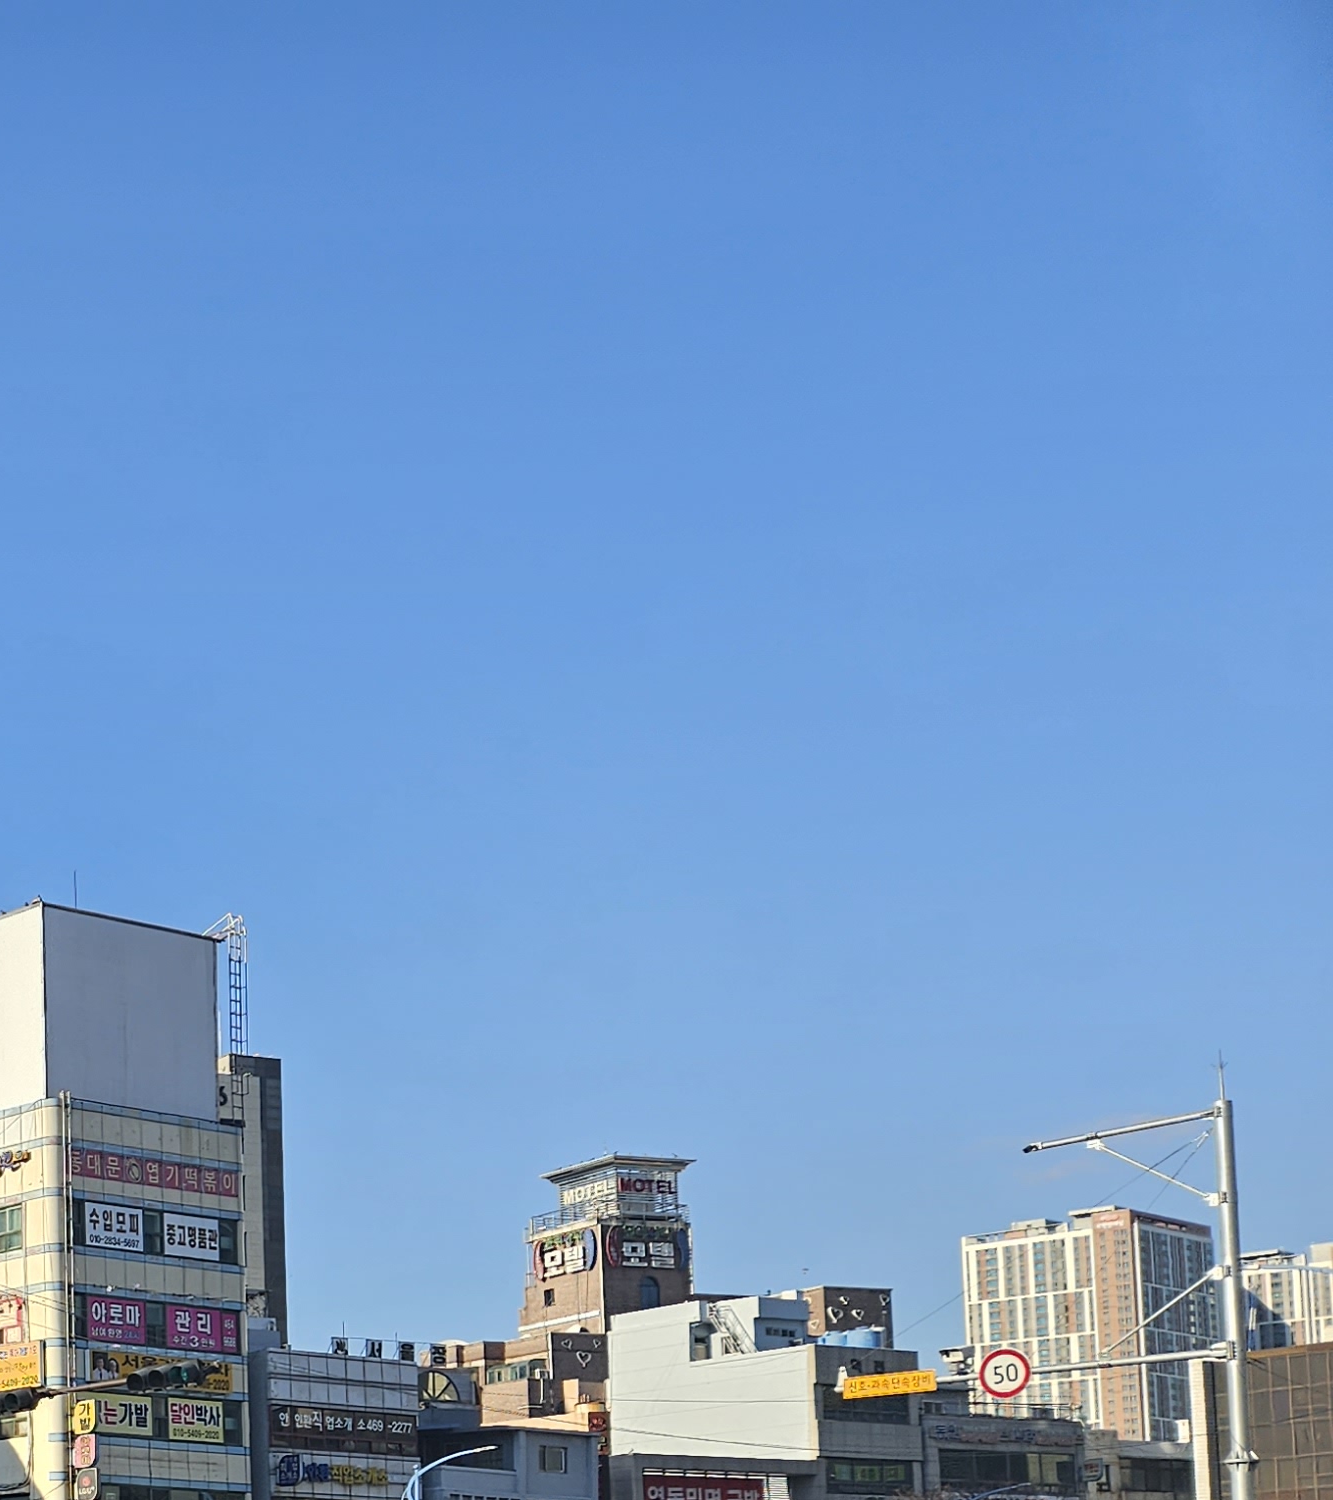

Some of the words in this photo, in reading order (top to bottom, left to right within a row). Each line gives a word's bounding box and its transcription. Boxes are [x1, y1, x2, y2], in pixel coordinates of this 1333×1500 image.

[145, 1161, 236, 1195] 엽기떡볶이
[618, 1177, 677, 1195] MOTEL
[562, 1180, 610, 1205] MOTEL
[89, 1207, 140, 1236] 수입모피
[166, 1223, 219, 1251] 중고명품관
[622, 1241, 676, 1269] 모텔
[91, 1301, 141, 1327] 아로마
[175, 1309, 212, 1335] 관리
[189, 1335, 200, 1348] 3
[848, 1373, 931, 1394] 신호·과속단속장비
[992, 1363, 1019, 1385] 50
[79, 1403, 91, 1431] 가발
[170, 1403, 221, 1427] 달인박사
